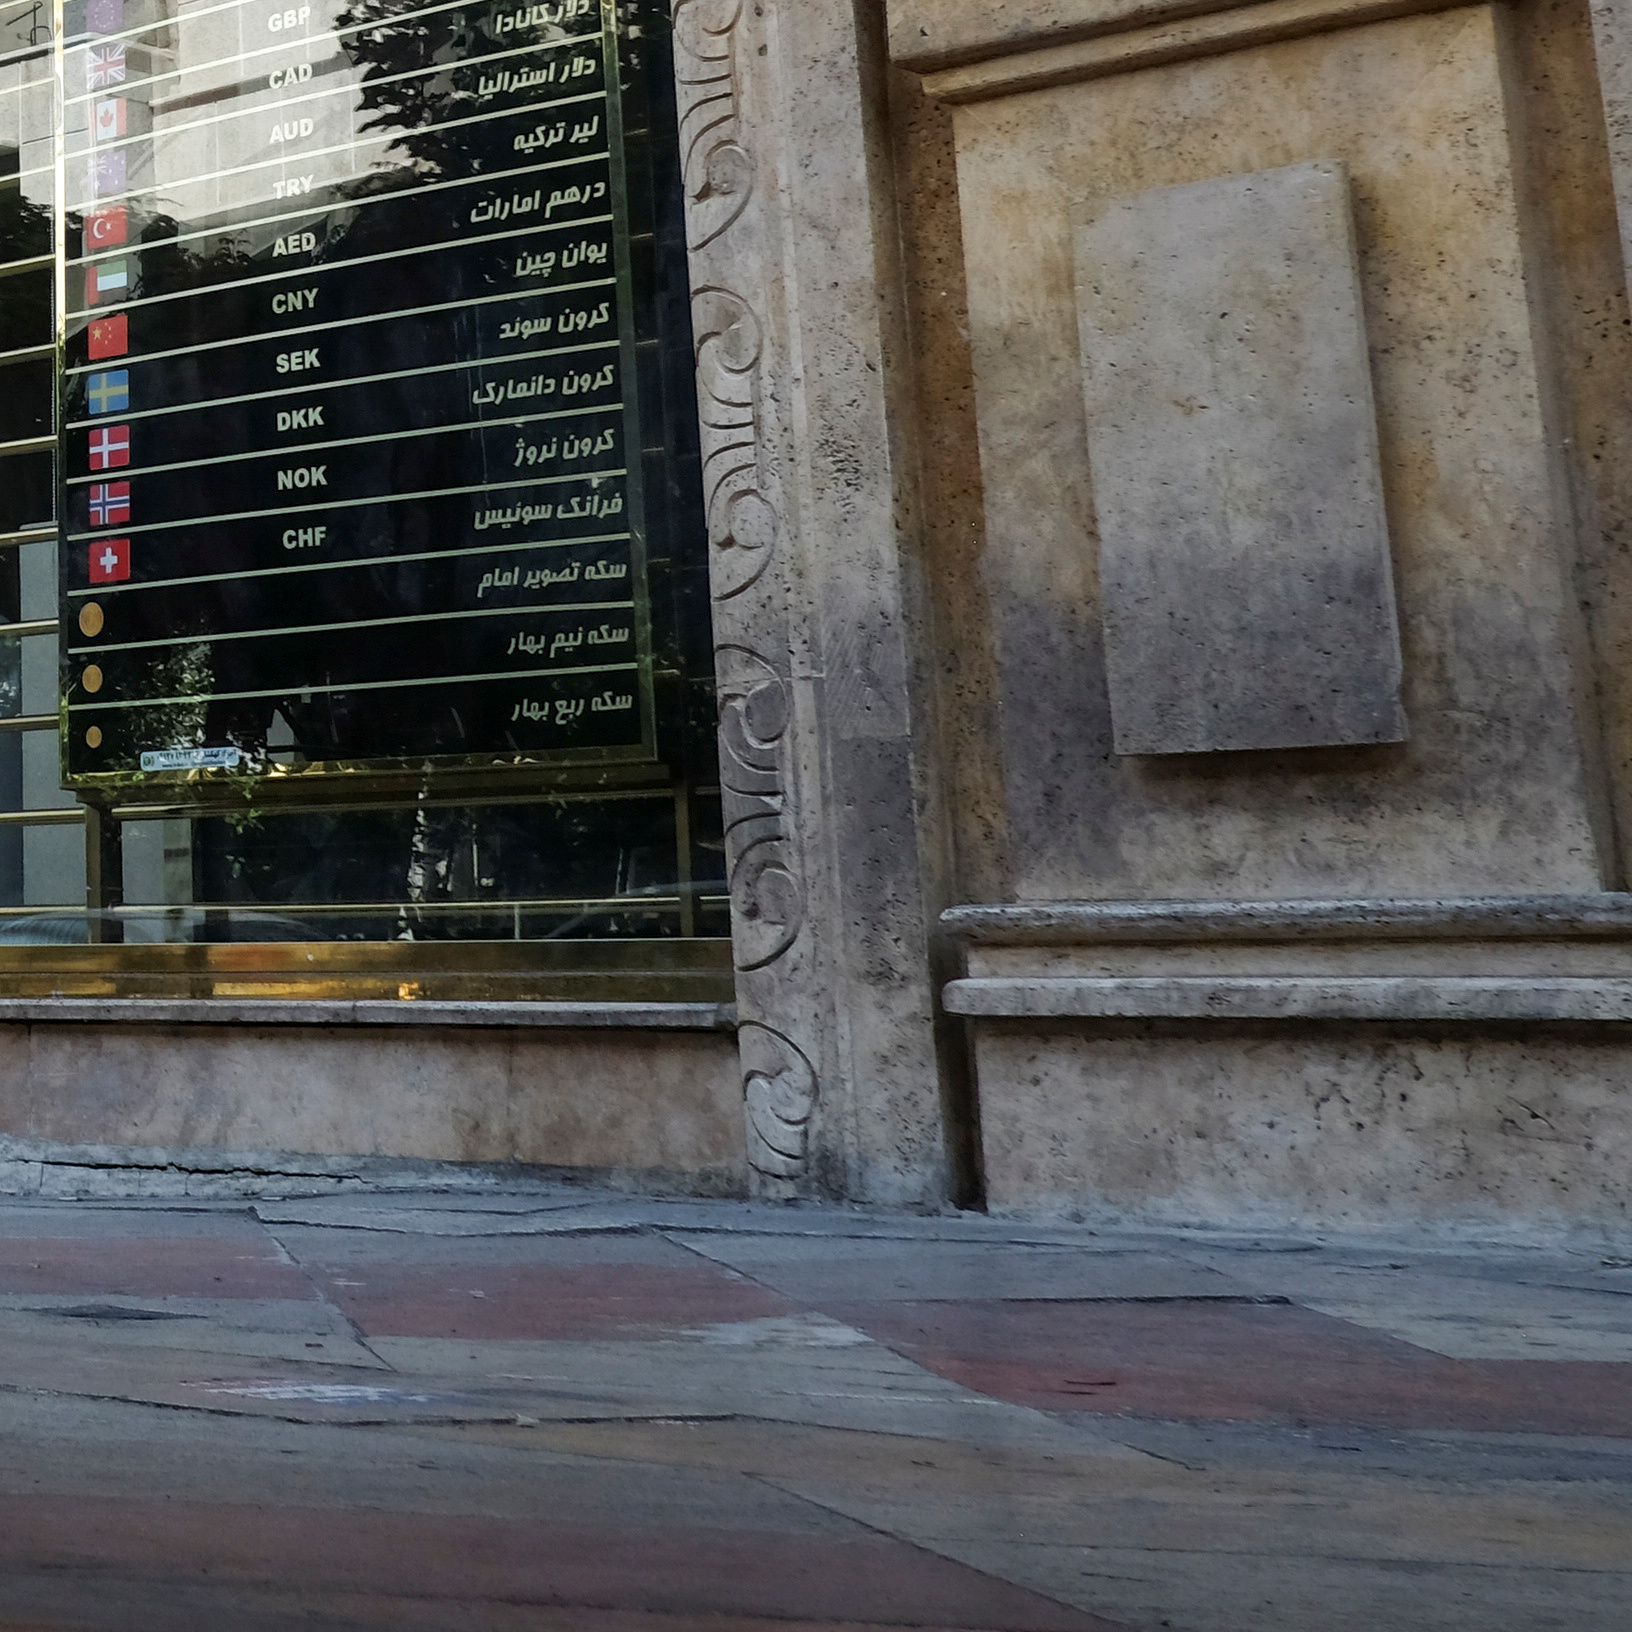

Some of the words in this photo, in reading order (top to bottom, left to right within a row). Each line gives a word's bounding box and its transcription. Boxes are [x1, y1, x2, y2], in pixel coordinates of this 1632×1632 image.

[268, 5, 311, 33] GBP
[495, 3, 550, 34] کانادا
[269, 63, 313, 90] CAD
[478, 62, 555, 100] استرالیا
[559, 56, 596, 83] دلار
[269, 117, 314, 145] AUD
[513, 121, 566, 154] ترکیه
[569, 115, 599, 144] لیر
[272, 174, 315, 200] TRY
[544, 181, 606, 218] درهم
[470, 189, 541, 223] امارات
[272, 232, 316, 258] AED
[561, 240, 608, 268] یوان
[514, 251, 556, 278] چین
[271, 287, 320, 314] CNY
[557, 302, 610, 333] کرون
[276, 347, 321, 374] SEK
[472, 374, 556, 405] دانمارک
[561, 364, 614, 395] کرون
[276, 406, 325, 432] DKK
[514, 437, 558, 467] نروژ
[562, 428, 615, 460] کرون
[277, 465, 329, 491] NOK
[556, 492, 623, 519] فرانک
[282, 526, 327, 550] CHF
[477, 566, 520, 598] امام
[523, 561, 581, 589] تصویر
[584, 560, 627, 581] سکه
[507, 631, 546, 656] بهار
[549, 626, 583, 659] نیم
[587, 624, 629, 645] سکه
[511, 698, 550, 721] بهار
[555, 698, 585, 725] ربع
[591, 691, 633, 711] سکه
